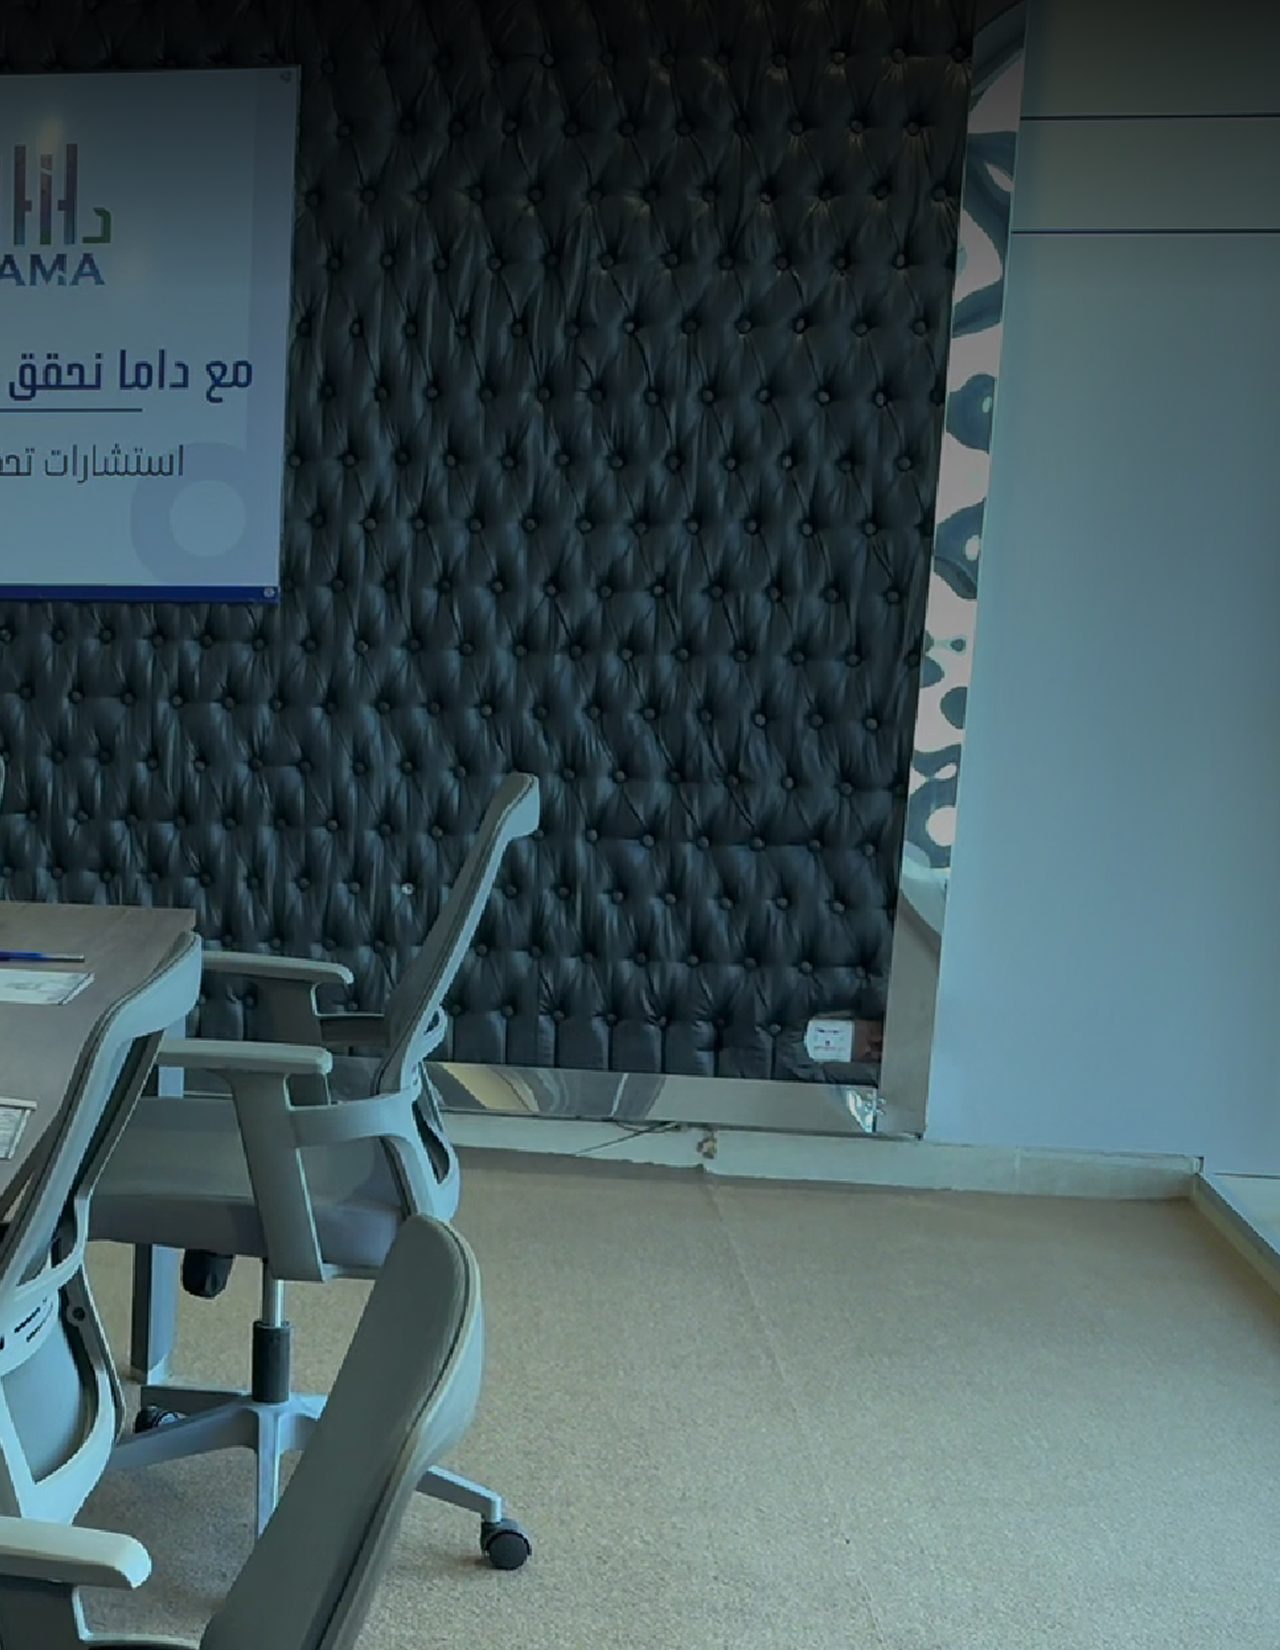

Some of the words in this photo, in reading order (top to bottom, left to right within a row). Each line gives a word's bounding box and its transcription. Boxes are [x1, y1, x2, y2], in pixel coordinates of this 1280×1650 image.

[8, 351, 103, 401] نحقق
[119, 349, 190, 391] داما
[205, 359, 253, 403] مع
[44, 443, 184, 484] استشارات
